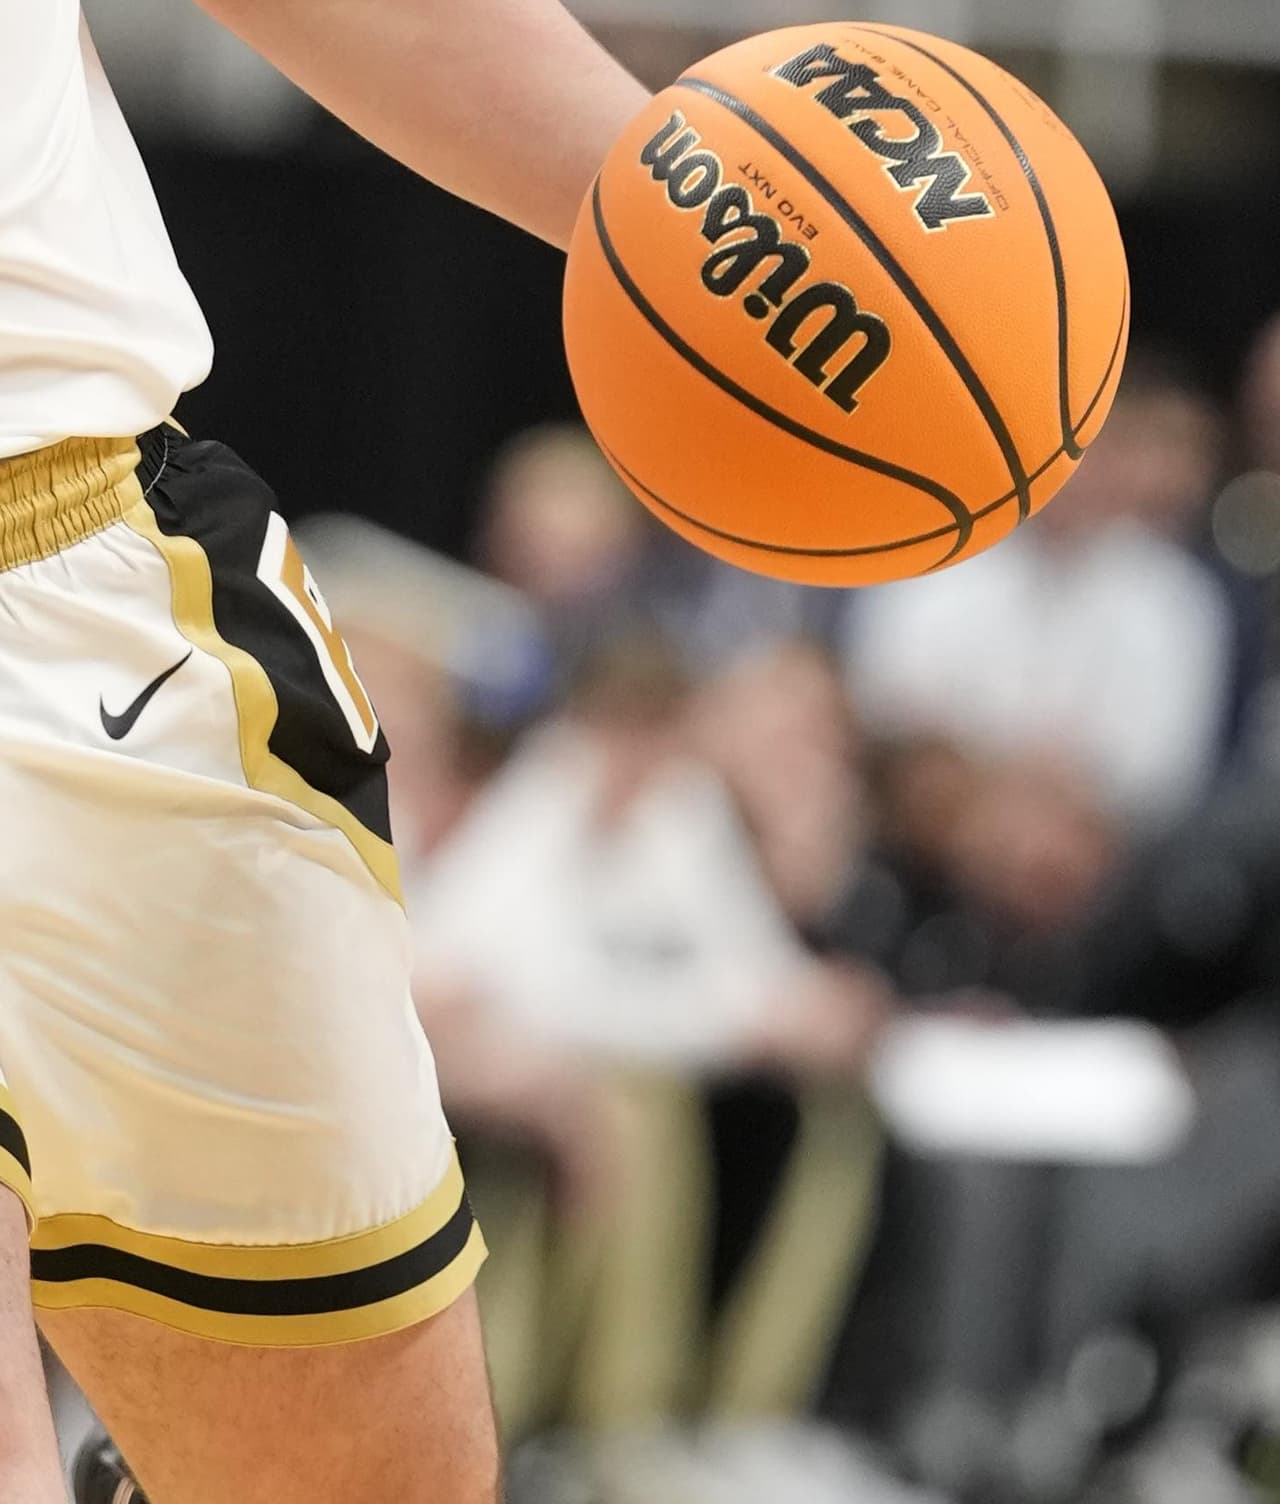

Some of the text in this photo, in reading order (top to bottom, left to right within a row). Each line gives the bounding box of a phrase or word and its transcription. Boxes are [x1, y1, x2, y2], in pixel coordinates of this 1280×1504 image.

[737, 162, 819, 240] EVO NXT
[769, 42, 996, 234] NCAA
[638, 109, 893, 416] Wilson
